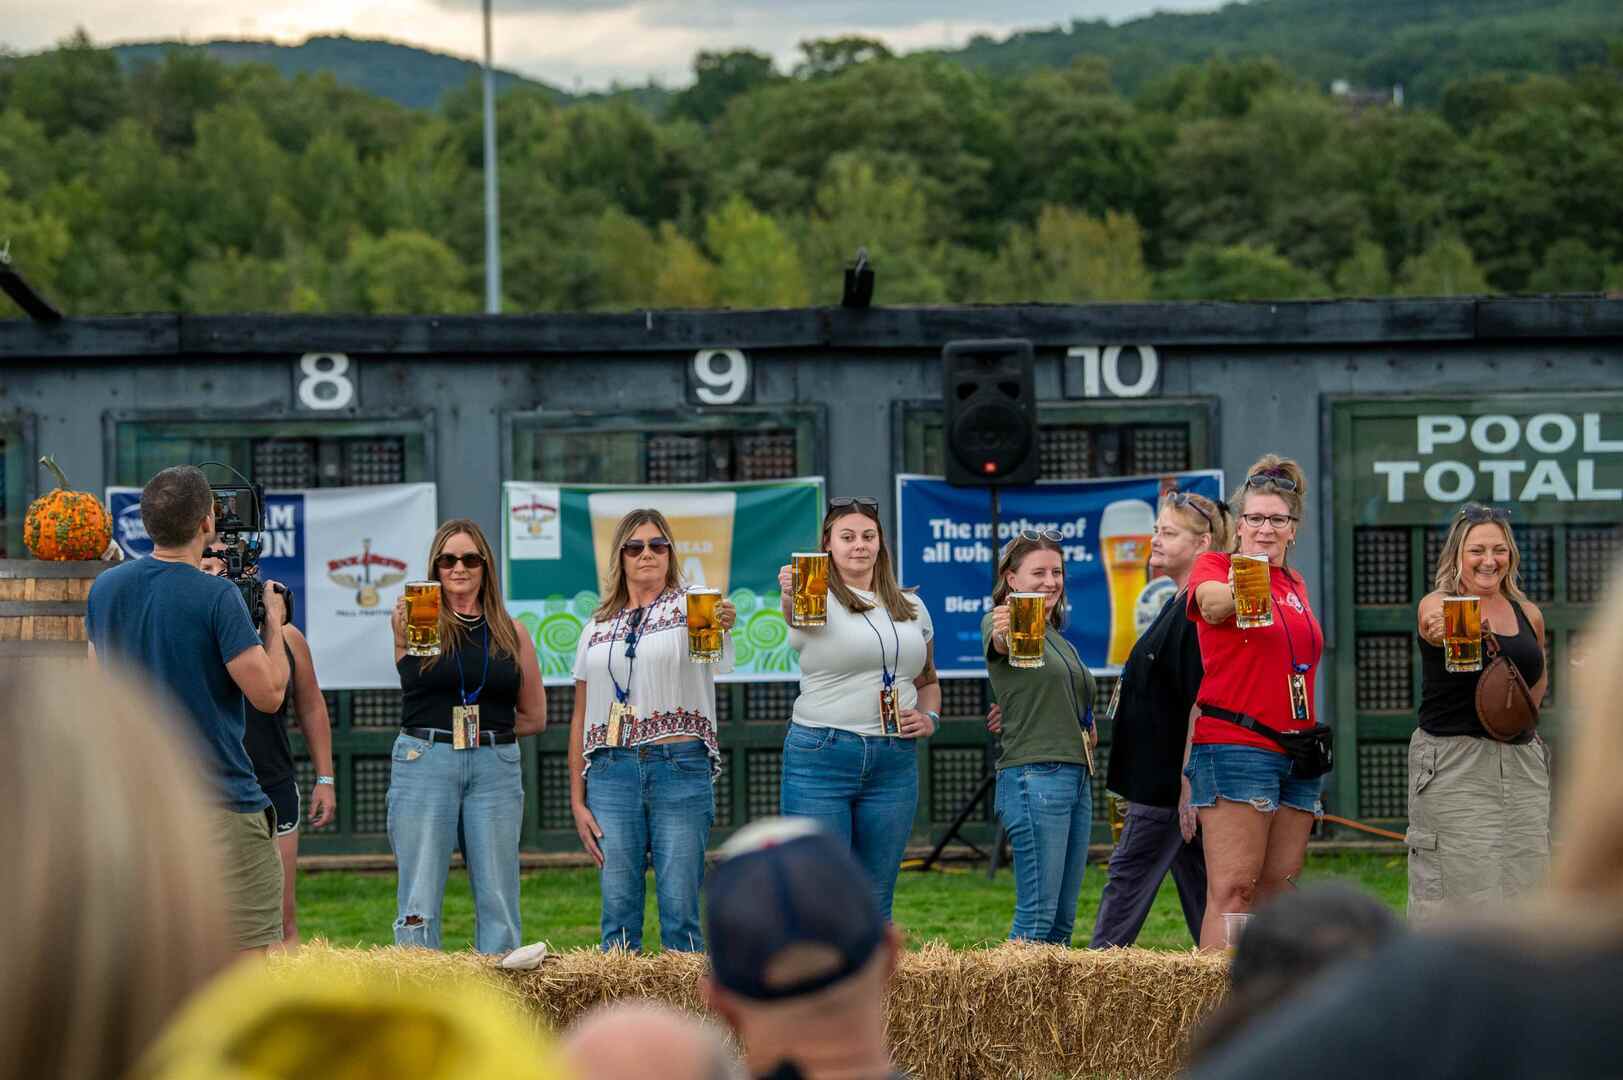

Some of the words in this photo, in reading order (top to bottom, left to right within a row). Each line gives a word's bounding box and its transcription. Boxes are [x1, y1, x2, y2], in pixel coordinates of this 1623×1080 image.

[299, 352, 354, 410] 8
[694, 348, 749, 405] 9
[1067, 345, 1158, 397] 10
[1417, 413, 1623, 454] POOL
[1373, 459, 1623, 503] TOTAL
[929, 518, 972, 539] The
[1061, 518, 1087, 539] of
[922, 542, 951, 563] all
[944, 596, 982, 613] Bier
